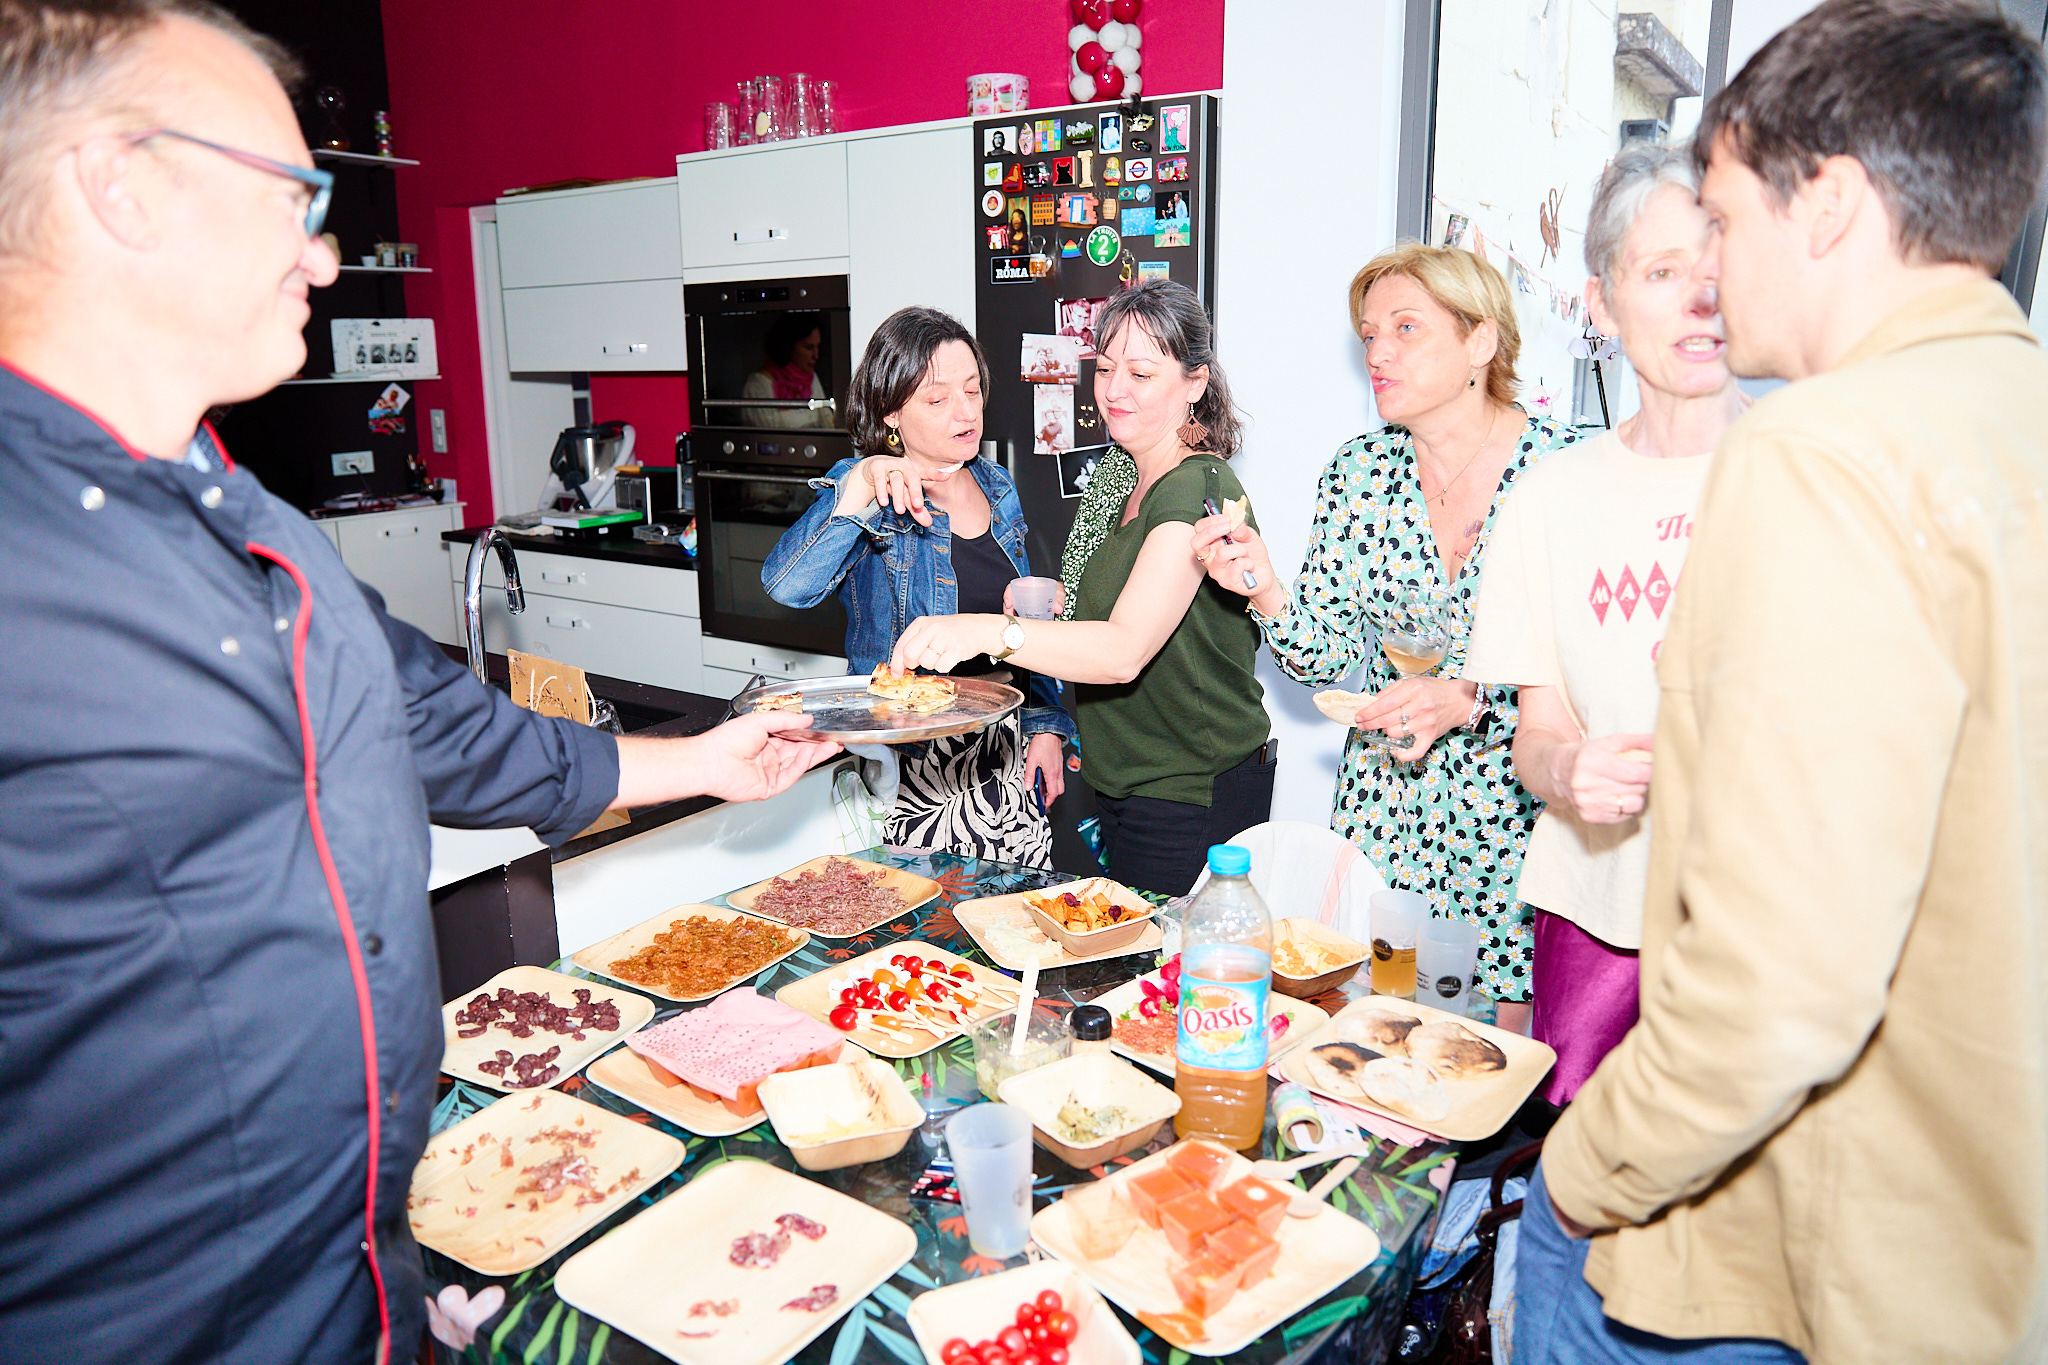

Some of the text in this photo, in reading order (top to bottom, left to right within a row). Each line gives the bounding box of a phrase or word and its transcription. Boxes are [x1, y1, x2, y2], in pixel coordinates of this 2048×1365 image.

[1089, 227, 1118, 244] LA TRUITE
[1097, 234, 1109, 256] 2
[1004, 258, 1011, 269] I
[995, 267, 1029, 279] ROMA
[1197, 987, 1236, 1000] TROPICAL
[1184, 1002, 1253, 1034] Oasis
